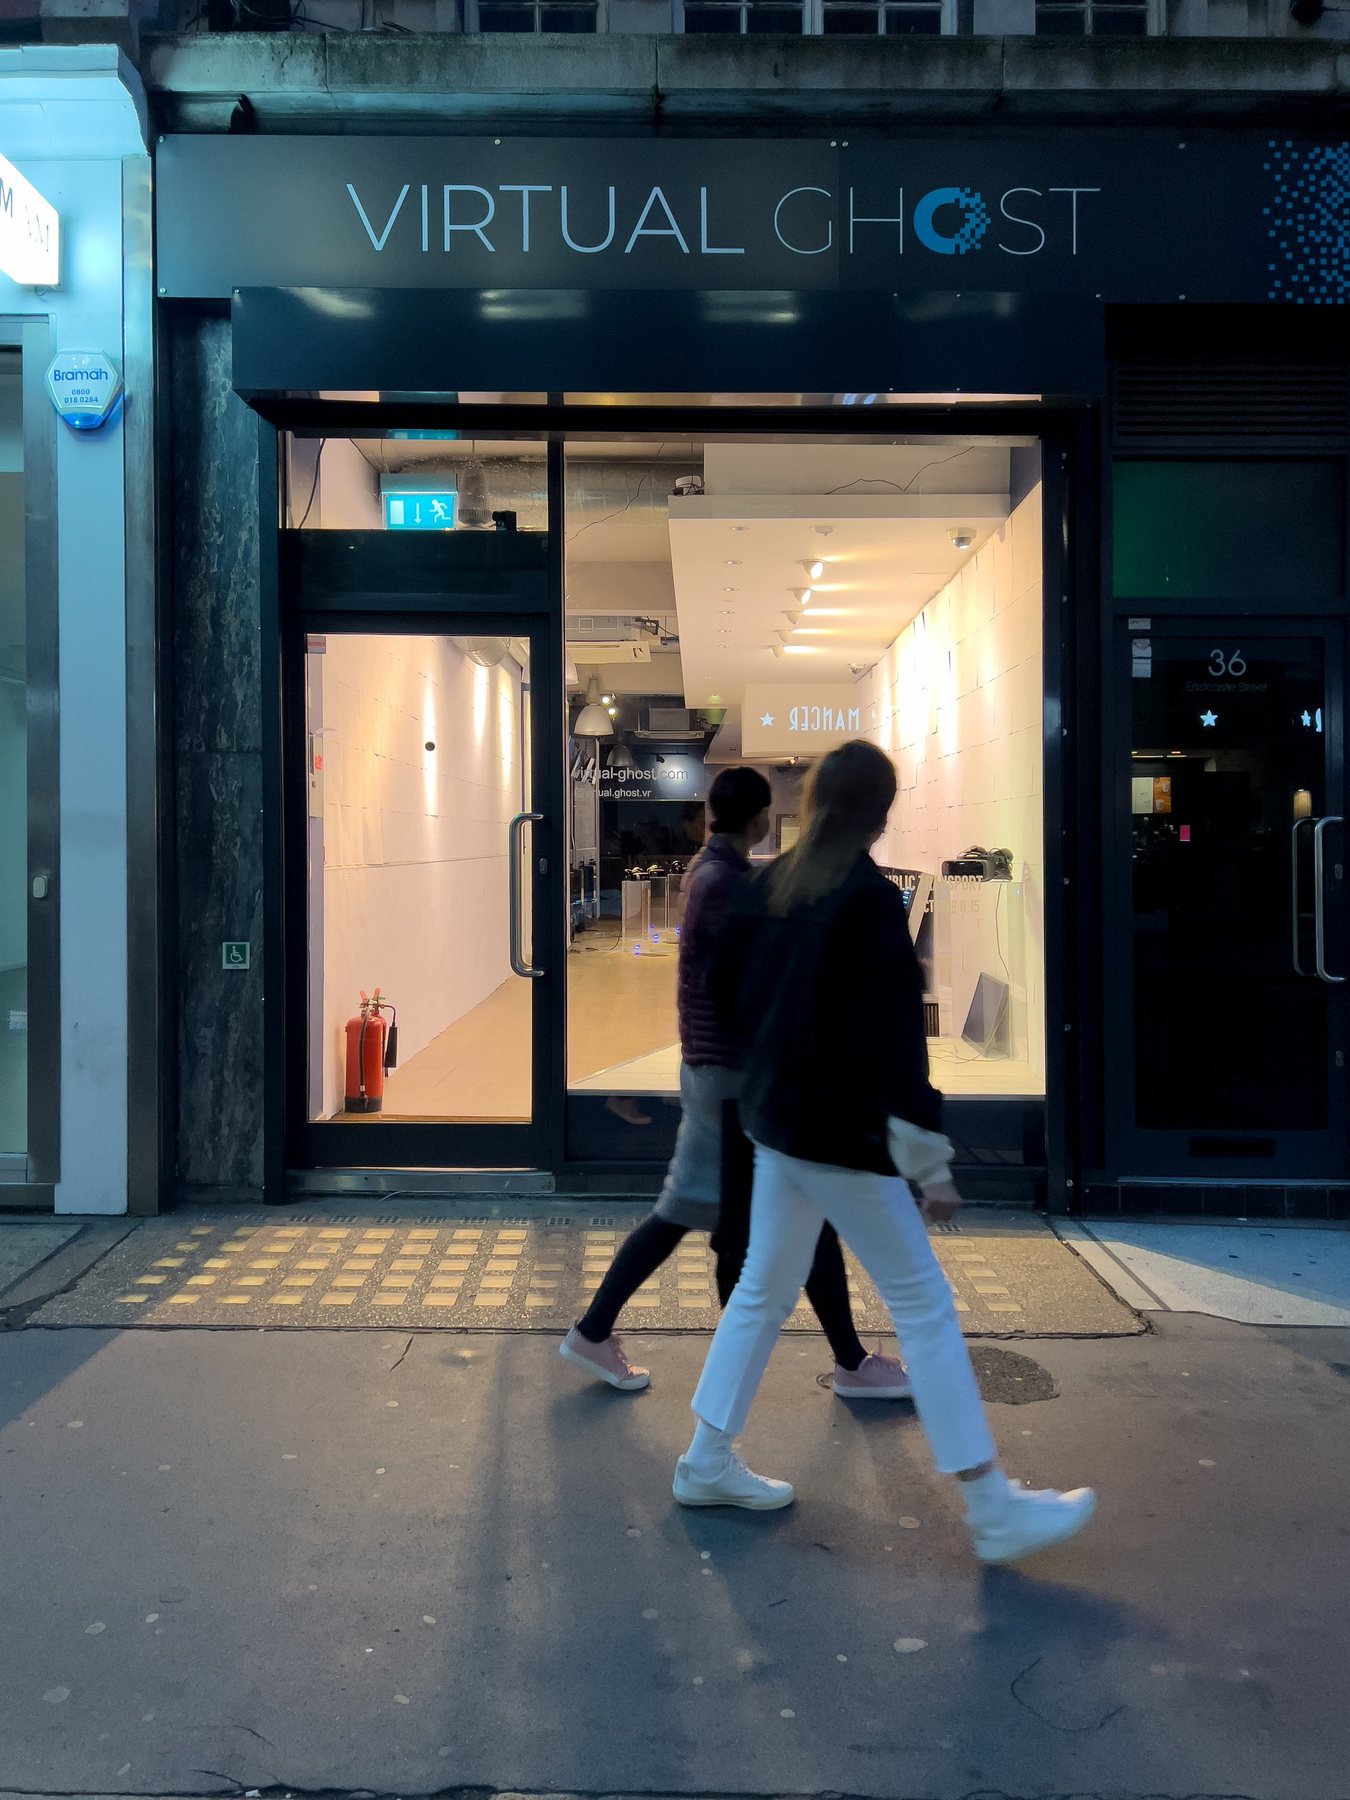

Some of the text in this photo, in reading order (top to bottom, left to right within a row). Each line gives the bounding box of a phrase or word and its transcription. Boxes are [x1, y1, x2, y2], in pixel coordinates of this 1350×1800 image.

[346, 183, 1102, 255] VIRTUAL GHOST
[53, 369, 109, 381] Bramah
[71, 388, 91, 396] 0800
[1207, 648, 1247, 677] 36
[1238, 681, 1268, 692] Street
[575, 766, 689, 782] virtual-ghostcom
[885, 874, 916, 891] BLIC
